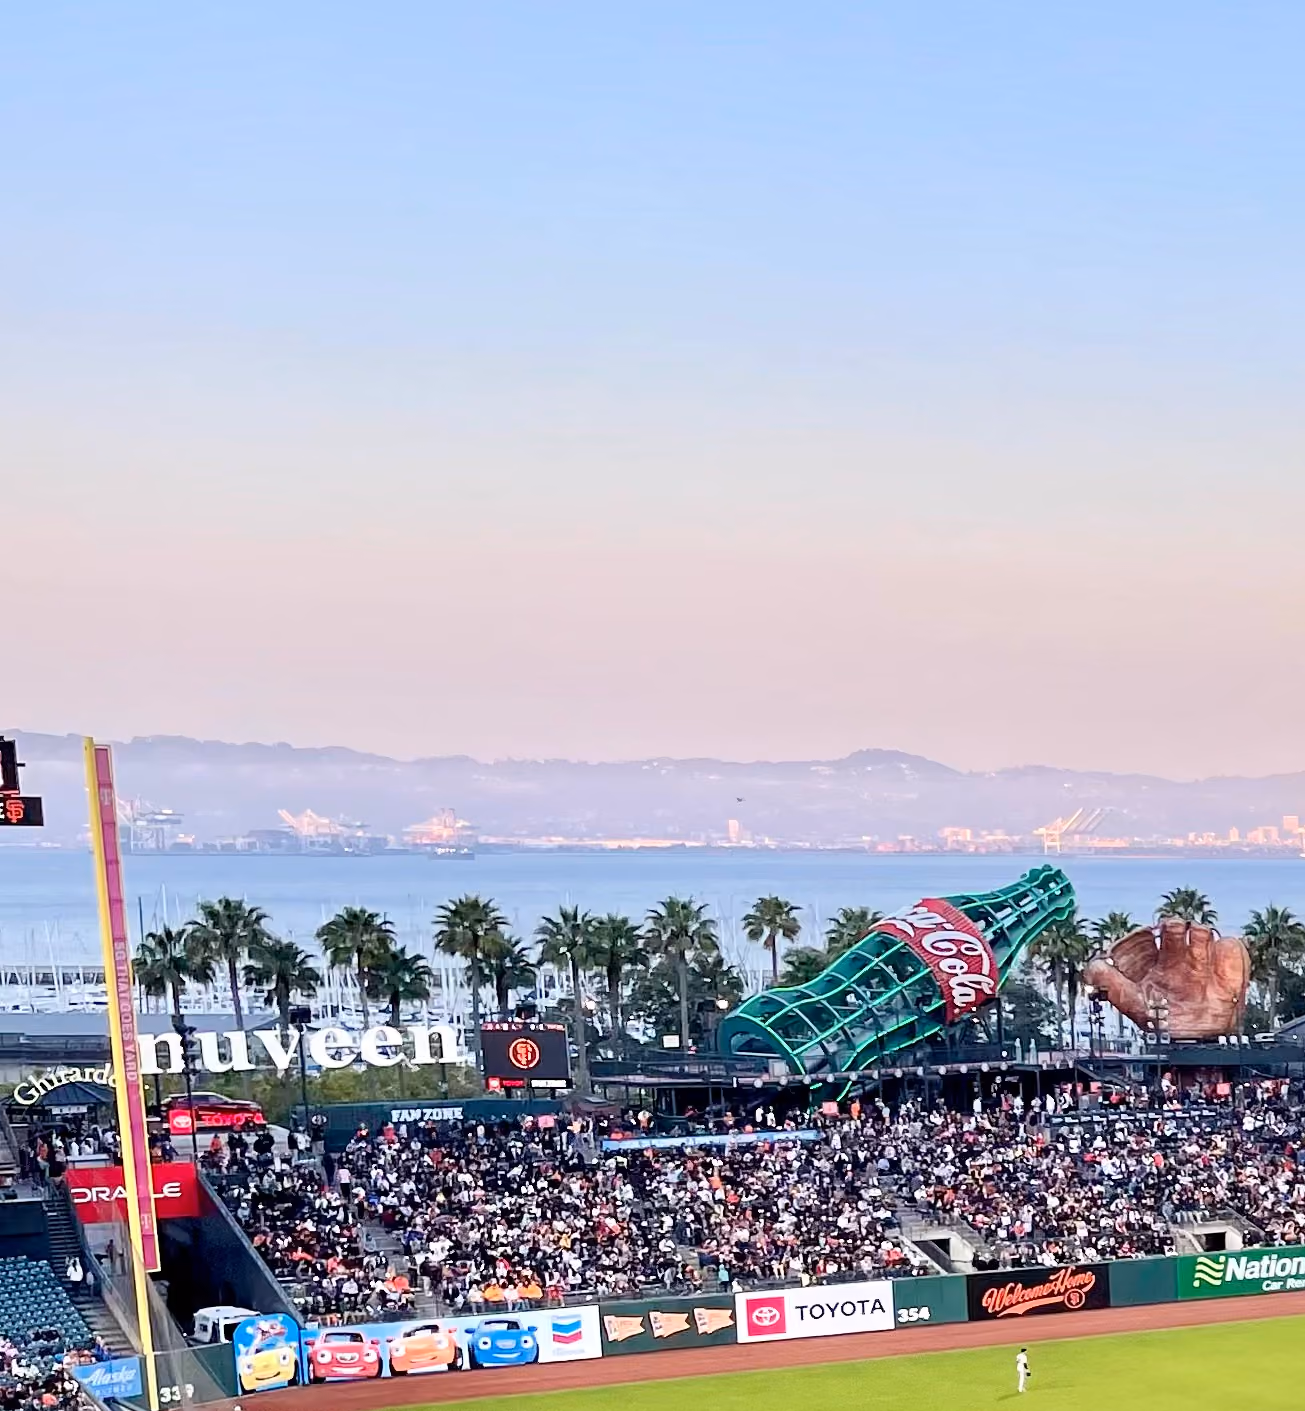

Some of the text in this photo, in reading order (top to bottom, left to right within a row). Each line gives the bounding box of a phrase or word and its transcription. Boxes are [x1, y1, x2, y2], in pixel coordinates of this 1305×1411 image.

[136, 1024, 466, 1076] nuveen
[390, 1106, 464, 1123] FAN ZONE
[70, 1182, 182, 1203] ORALE
[981, 1265, 1096, 1314] Welcome Home
[1262, 1279, 1283, 1292] Car
[795, 1298, 886, 1321] TOYOTA
[897, 1306, 931, 1323] 354
